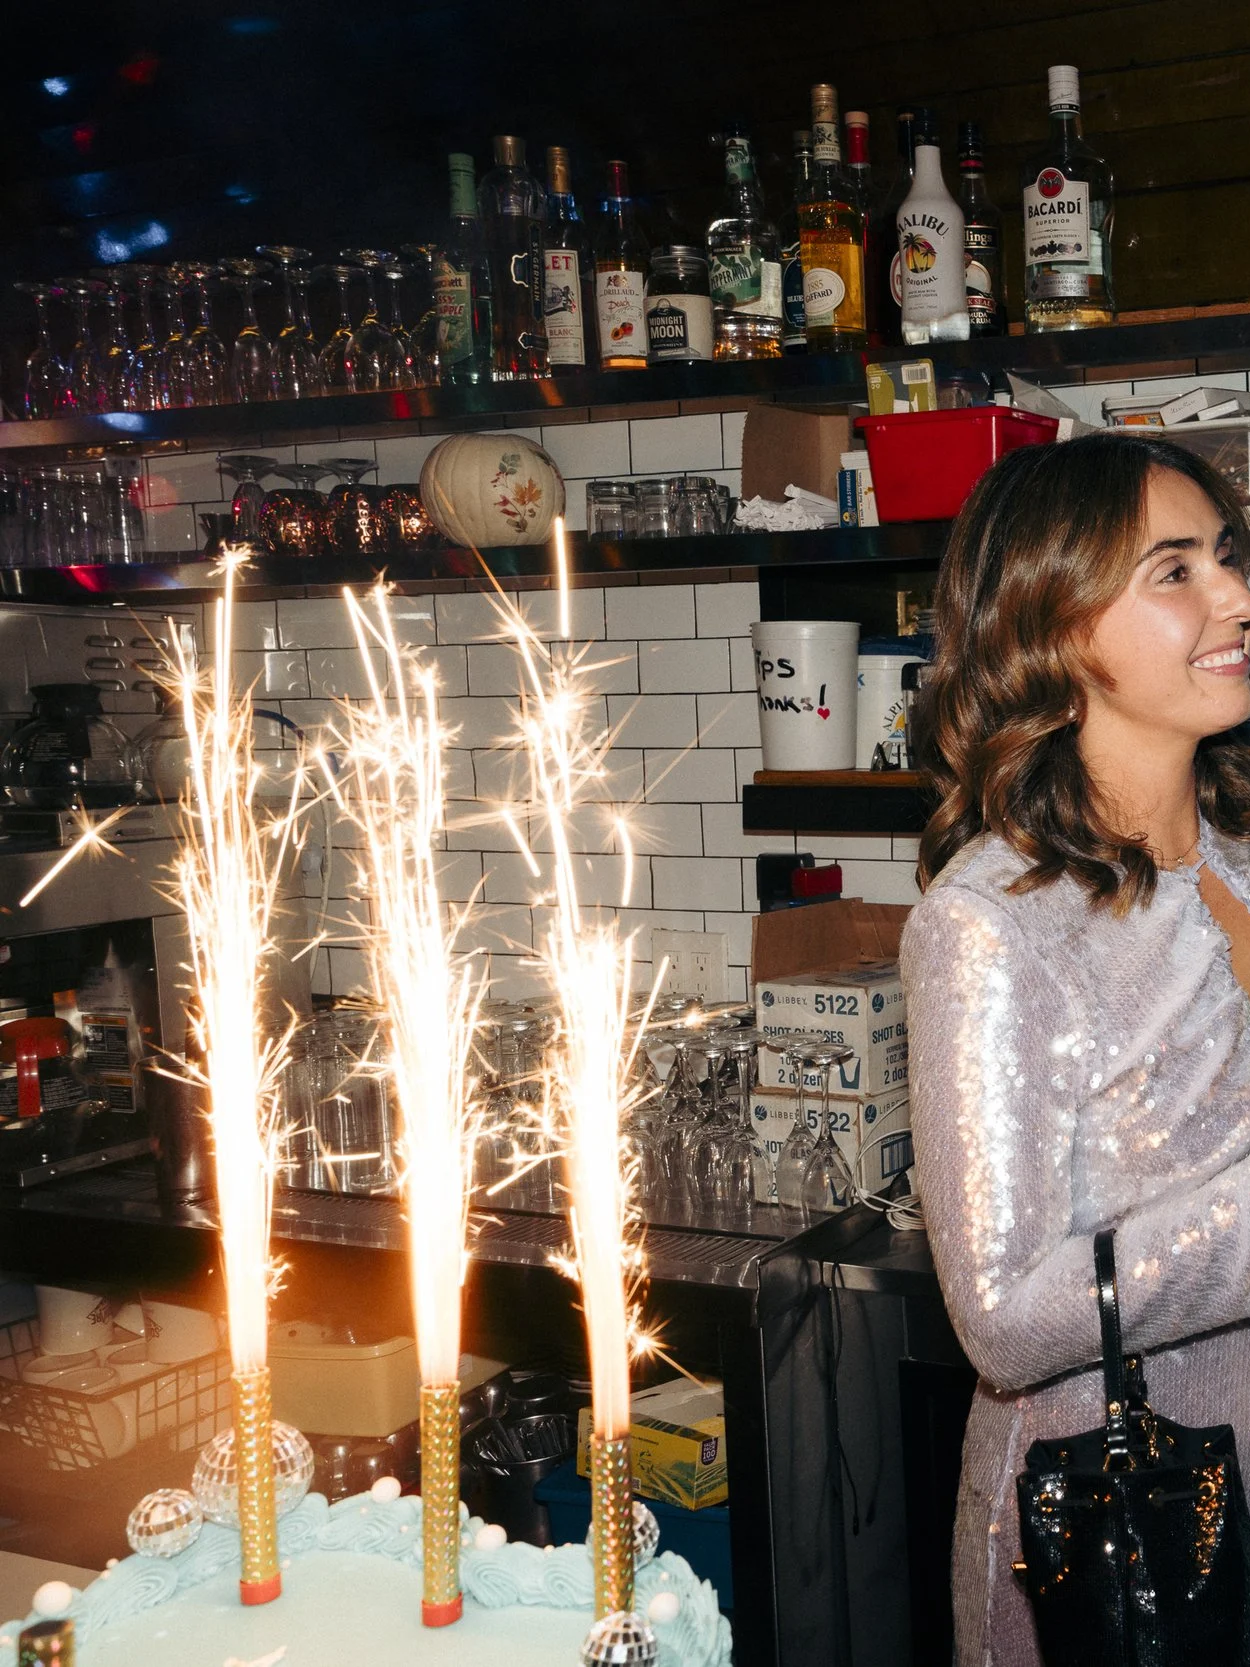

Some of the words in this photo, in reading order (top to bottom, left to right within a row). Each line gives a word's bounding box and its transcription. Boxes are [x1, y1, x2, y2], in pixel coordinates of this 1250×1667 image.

[1028, 197, 1081, 219] BACARDÍ
[1036, 218, 1070, 226] SUPERIOR
[906, 275, 938, 286] ORIGINAL
[975, 299, 992, 307] SEAL
[649, 315, 684, 325] MIDNIGHT
[549, 328, 575, 336] BLANC
[650, 325, 685, 339] MOON
[756, 650, 796, 682] ips
[758, 683, 827, 713] hanks!
[882, 699, 904, 732] ALPI
[777, 995, 807, 1006] LIBBEY
[814, 993, 859, 1016] 5122
[886, 991, 905, 1005] LIBB
[872, 1026, 893, 1045] SHOT
[778, 1069, 786, 1083] 2
[789, 1070, 822, 1086] dzen
[884, 1069, 890, 1085] 2
[892, 1067, 908, 1082] doz
[807, 1109, 850, 1133] 522
[703, 1450, 716, 1460] 100
